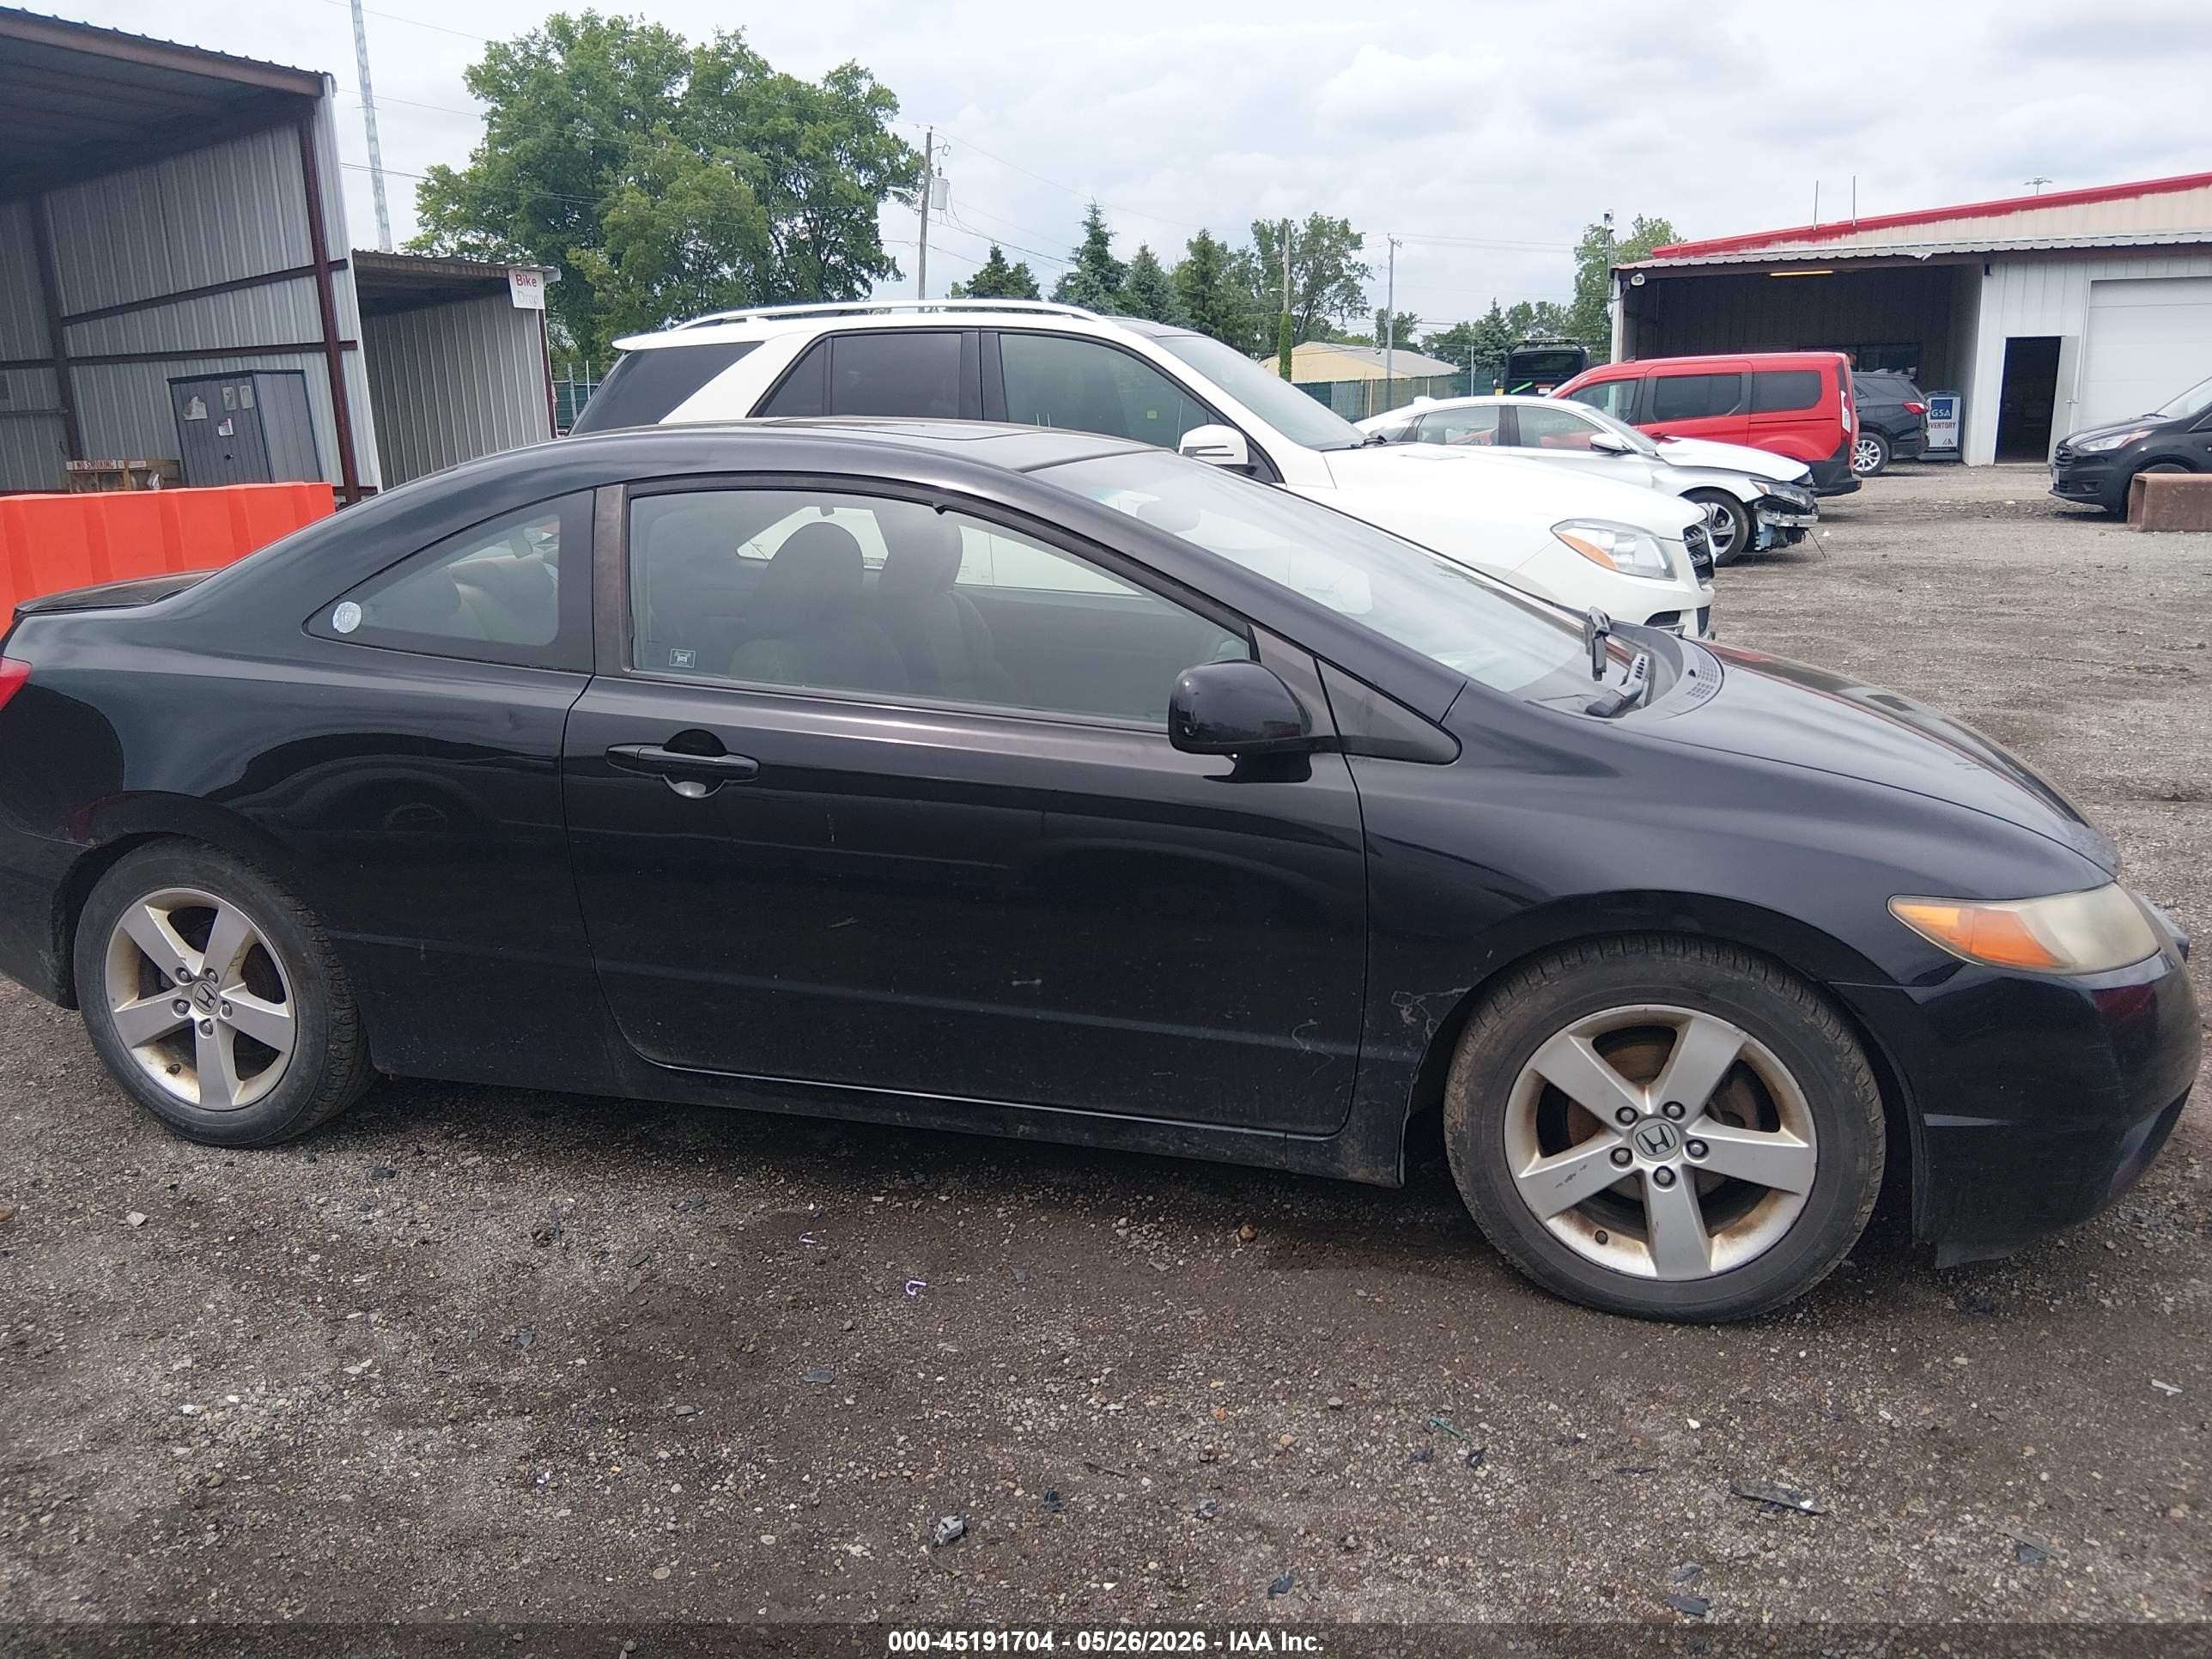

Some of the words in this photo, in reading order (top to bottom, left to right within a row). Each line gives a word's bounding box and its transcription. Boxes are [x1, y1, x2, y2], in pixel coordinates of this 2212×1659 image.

[515, 274, 537, 287] Bike
[517, 290, 539, 304] Drop
[1931, 409, 1951, 417] GSA
[77, 460, 85, 469] NO
